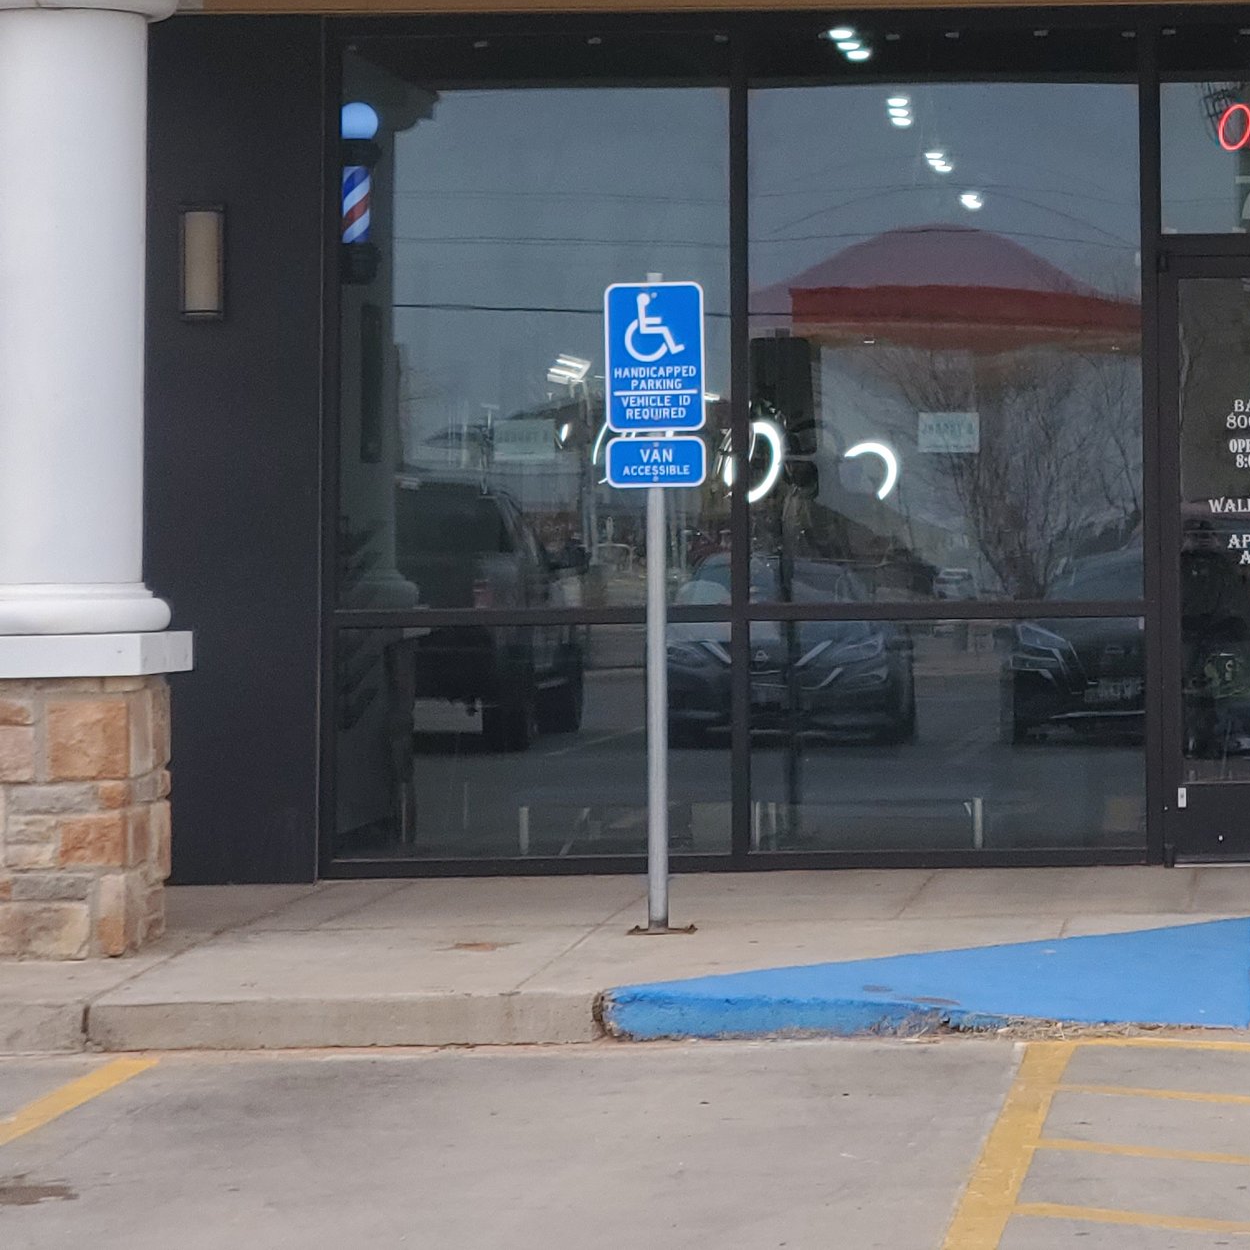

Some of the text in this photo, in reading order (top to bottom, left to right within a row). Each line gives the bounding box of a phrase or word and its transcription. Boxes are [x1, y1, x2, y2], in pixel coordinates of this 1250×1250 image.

[614, 366, 697, 379] HANDICAPPED
[631, 378, 682, 390] PARKING
[621, 395, 691, 407] VEHICLE ID
[626, 408, 686, 420] REQUIRED
[639, 448, 673, 463] VAN
[623, 465, 690, 476] ACCESSIBLE
